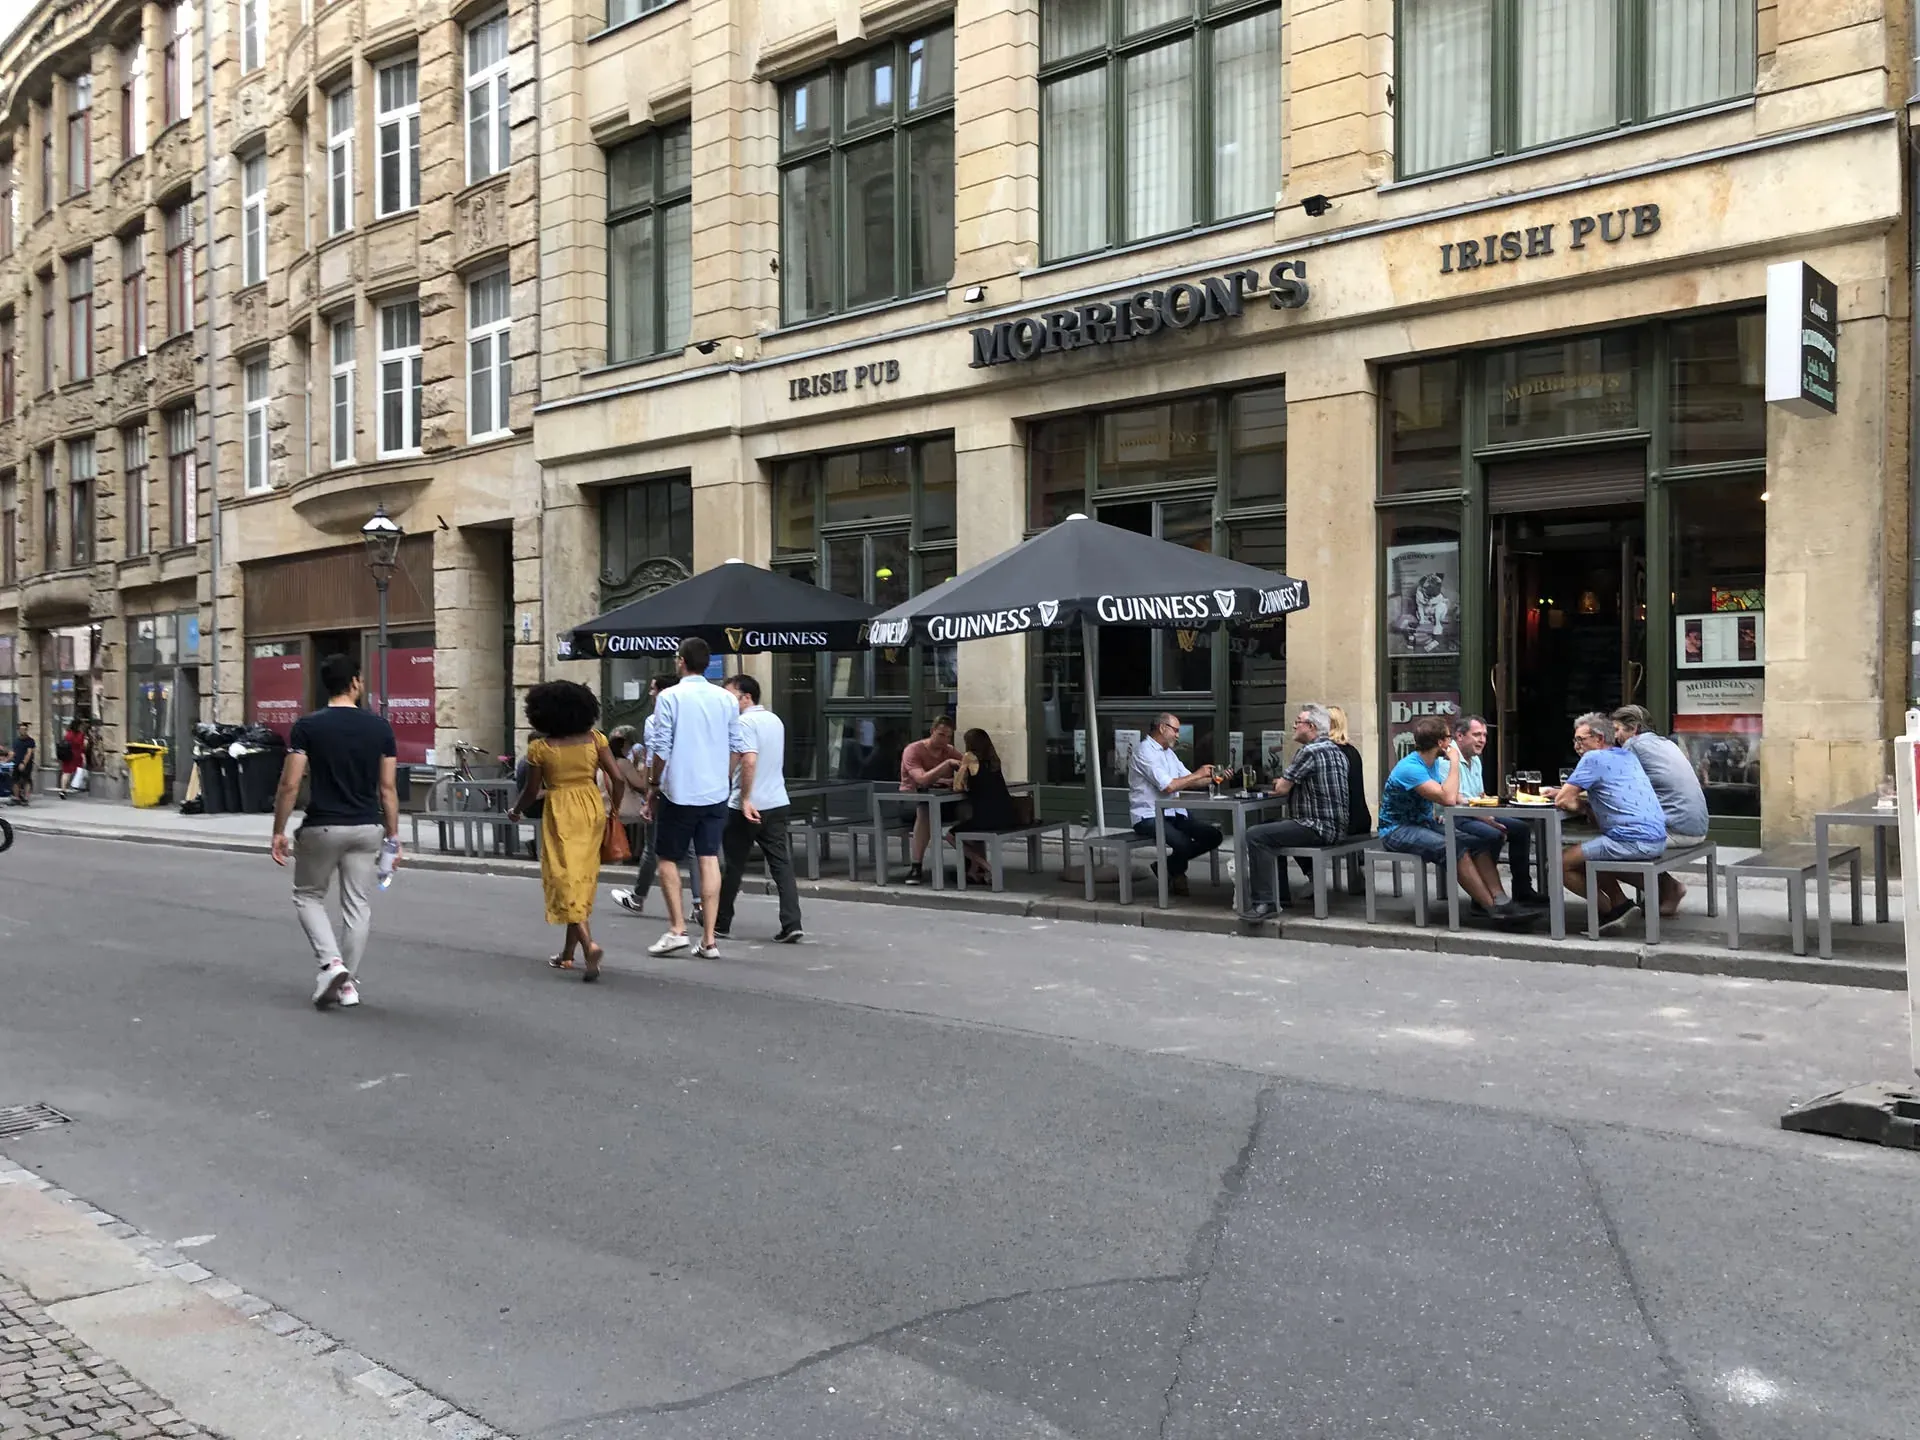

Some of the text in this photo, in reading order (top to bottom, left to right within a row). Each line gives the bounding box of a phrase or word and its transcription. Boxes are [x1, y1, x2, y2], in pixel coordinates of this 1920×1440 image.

[1440, 203, 1662, 274] IRISH PUB
[968, 259, 1310, 369] MORRISON'S
[788, 358, 900, 401] IRISH PUB
[1096, 594, 1209, 622] GUINNESS
[1258, 588, 1295, 615] GUINNESS
[927, 607, 1032, 642] GUINNESS
[608, 635, 680, 653] GUINNESS
[745, 630, 828, 648] GUINNESS
[1686, 680, 1756, 692] MORRISON'S
[1391, 700, 1457, 723] BIER
